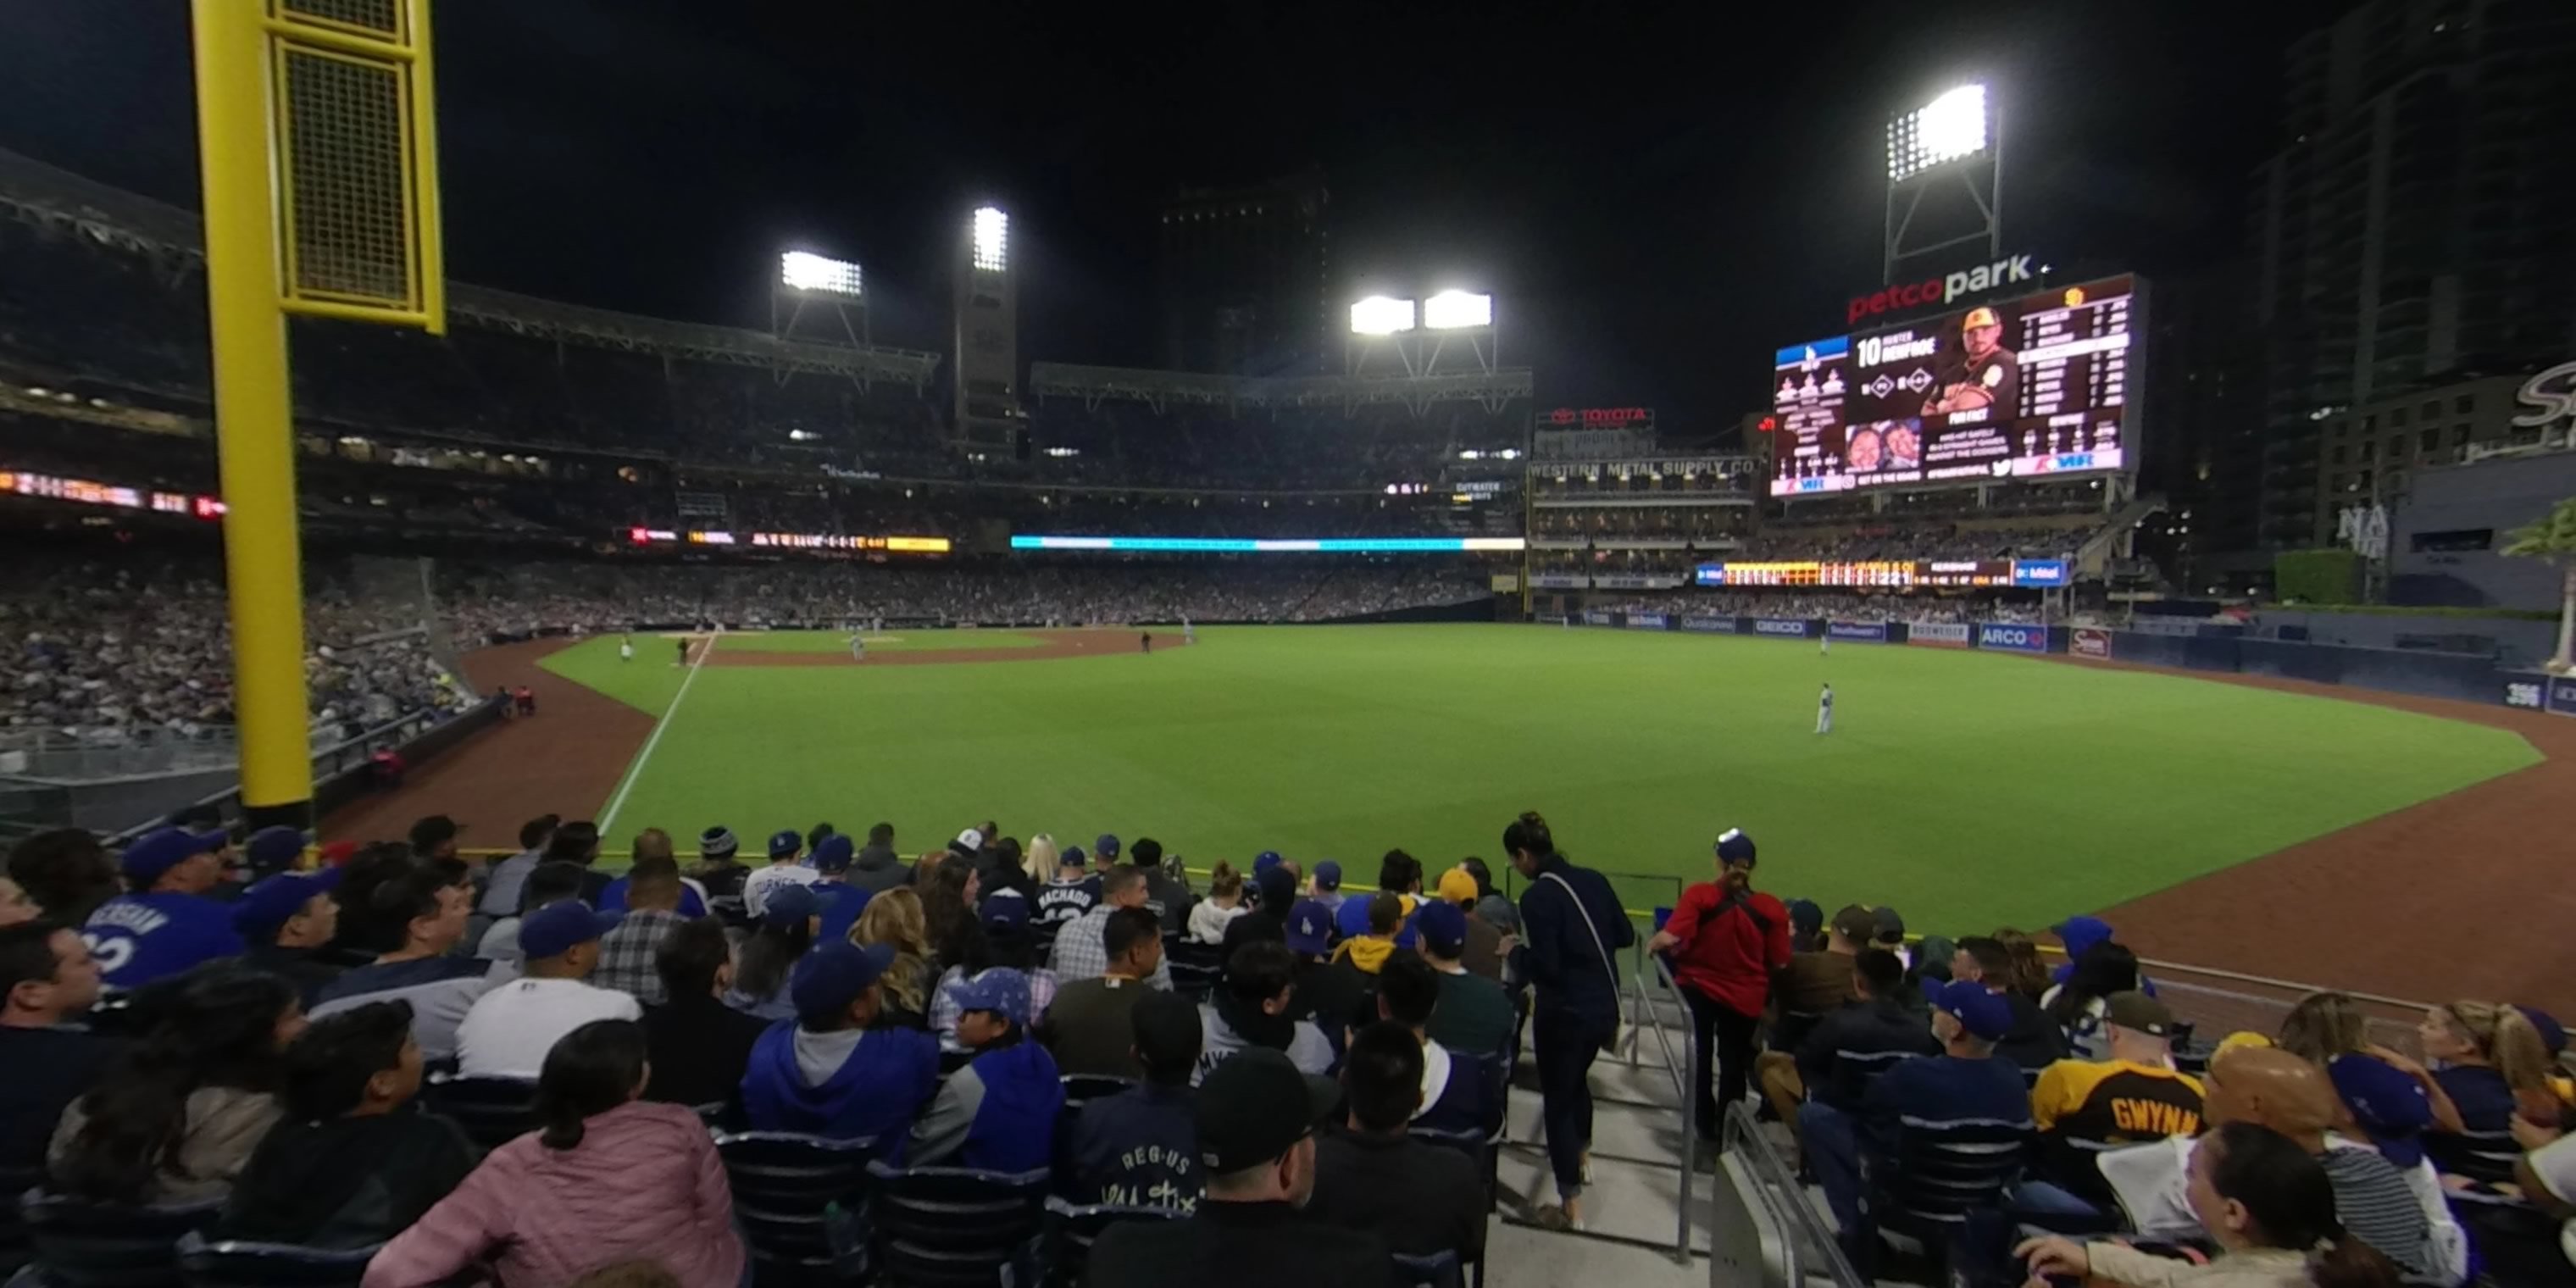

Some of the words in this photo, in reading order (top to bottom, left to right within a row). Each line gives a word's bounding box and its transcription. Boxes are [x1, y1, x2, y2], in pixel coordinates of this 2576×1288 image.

[1857, 336, 1881, 369] 10
[1581, 408, 1646, 421] TOYOTA
[1530, 464, 1600, 477] WESTERN
[1607, 463, 1654, 476] METAL
[1663, 462, 1723, 475] SUPPLY
[1757, 620, 1803, 634] GEICO
[1981, 629, 2027, 645] ARCO
[2110, 1097, 2200, 1135] GWYNN
